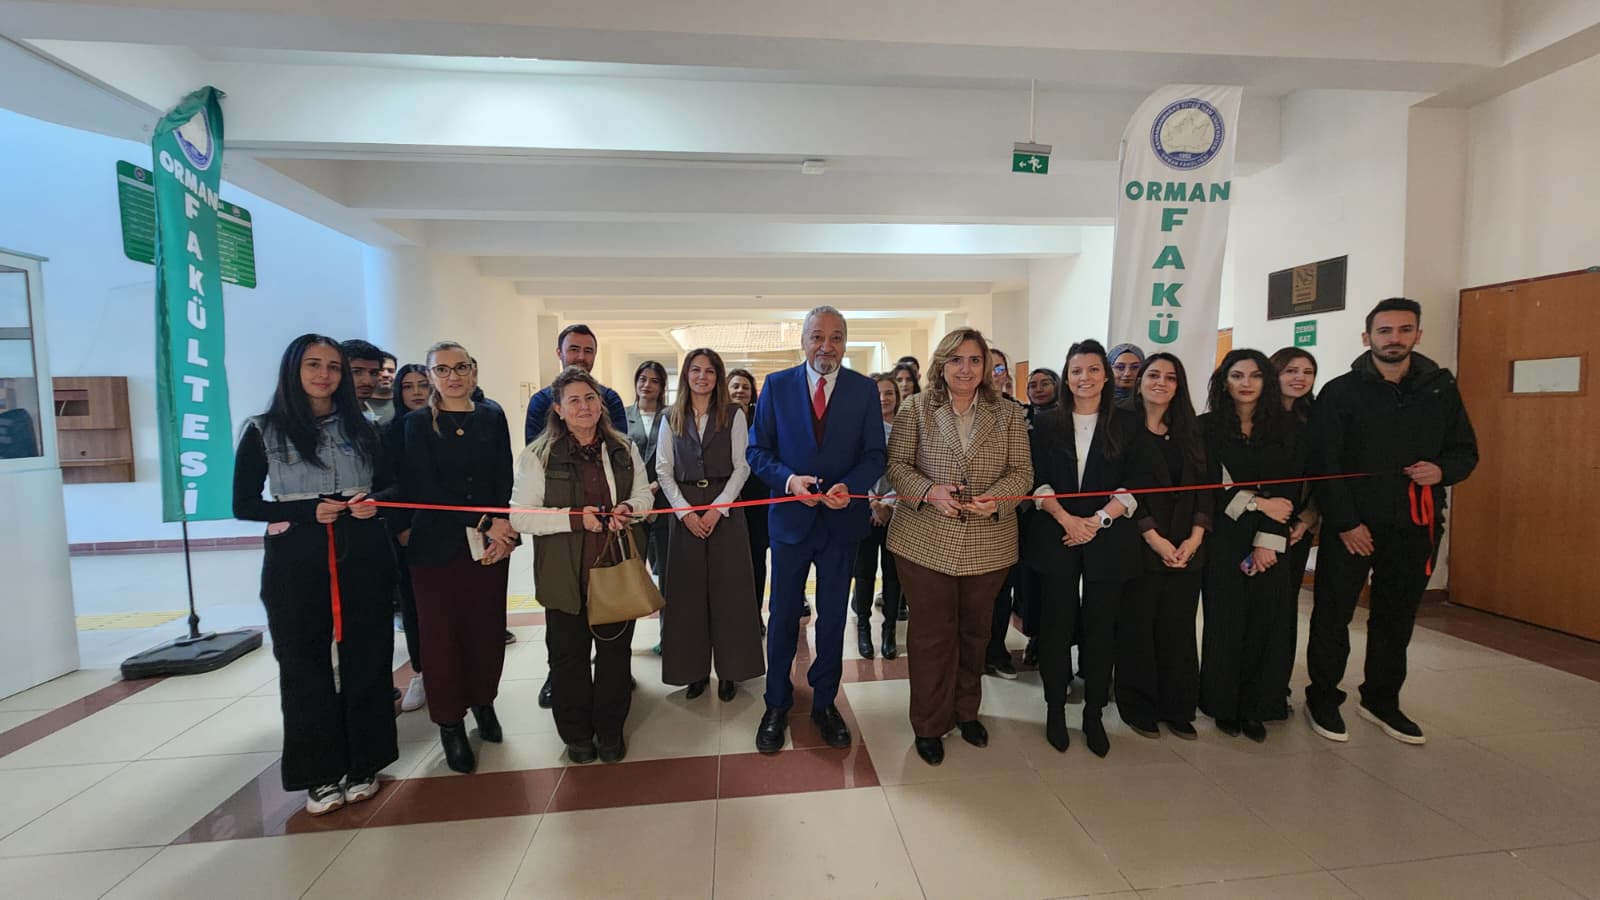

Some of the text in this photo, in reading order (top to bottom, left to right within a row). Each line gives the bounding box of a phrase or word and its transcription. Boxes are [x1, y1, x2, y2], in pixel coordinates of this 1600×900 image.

[159, 150, 219, 211] ORMAN
[1125, 180, 1231, 202] ORMAN
[1148, 207, 1189, 344] FAKÜ
[180, 192, 210, 514] FAKÜLTESİ
